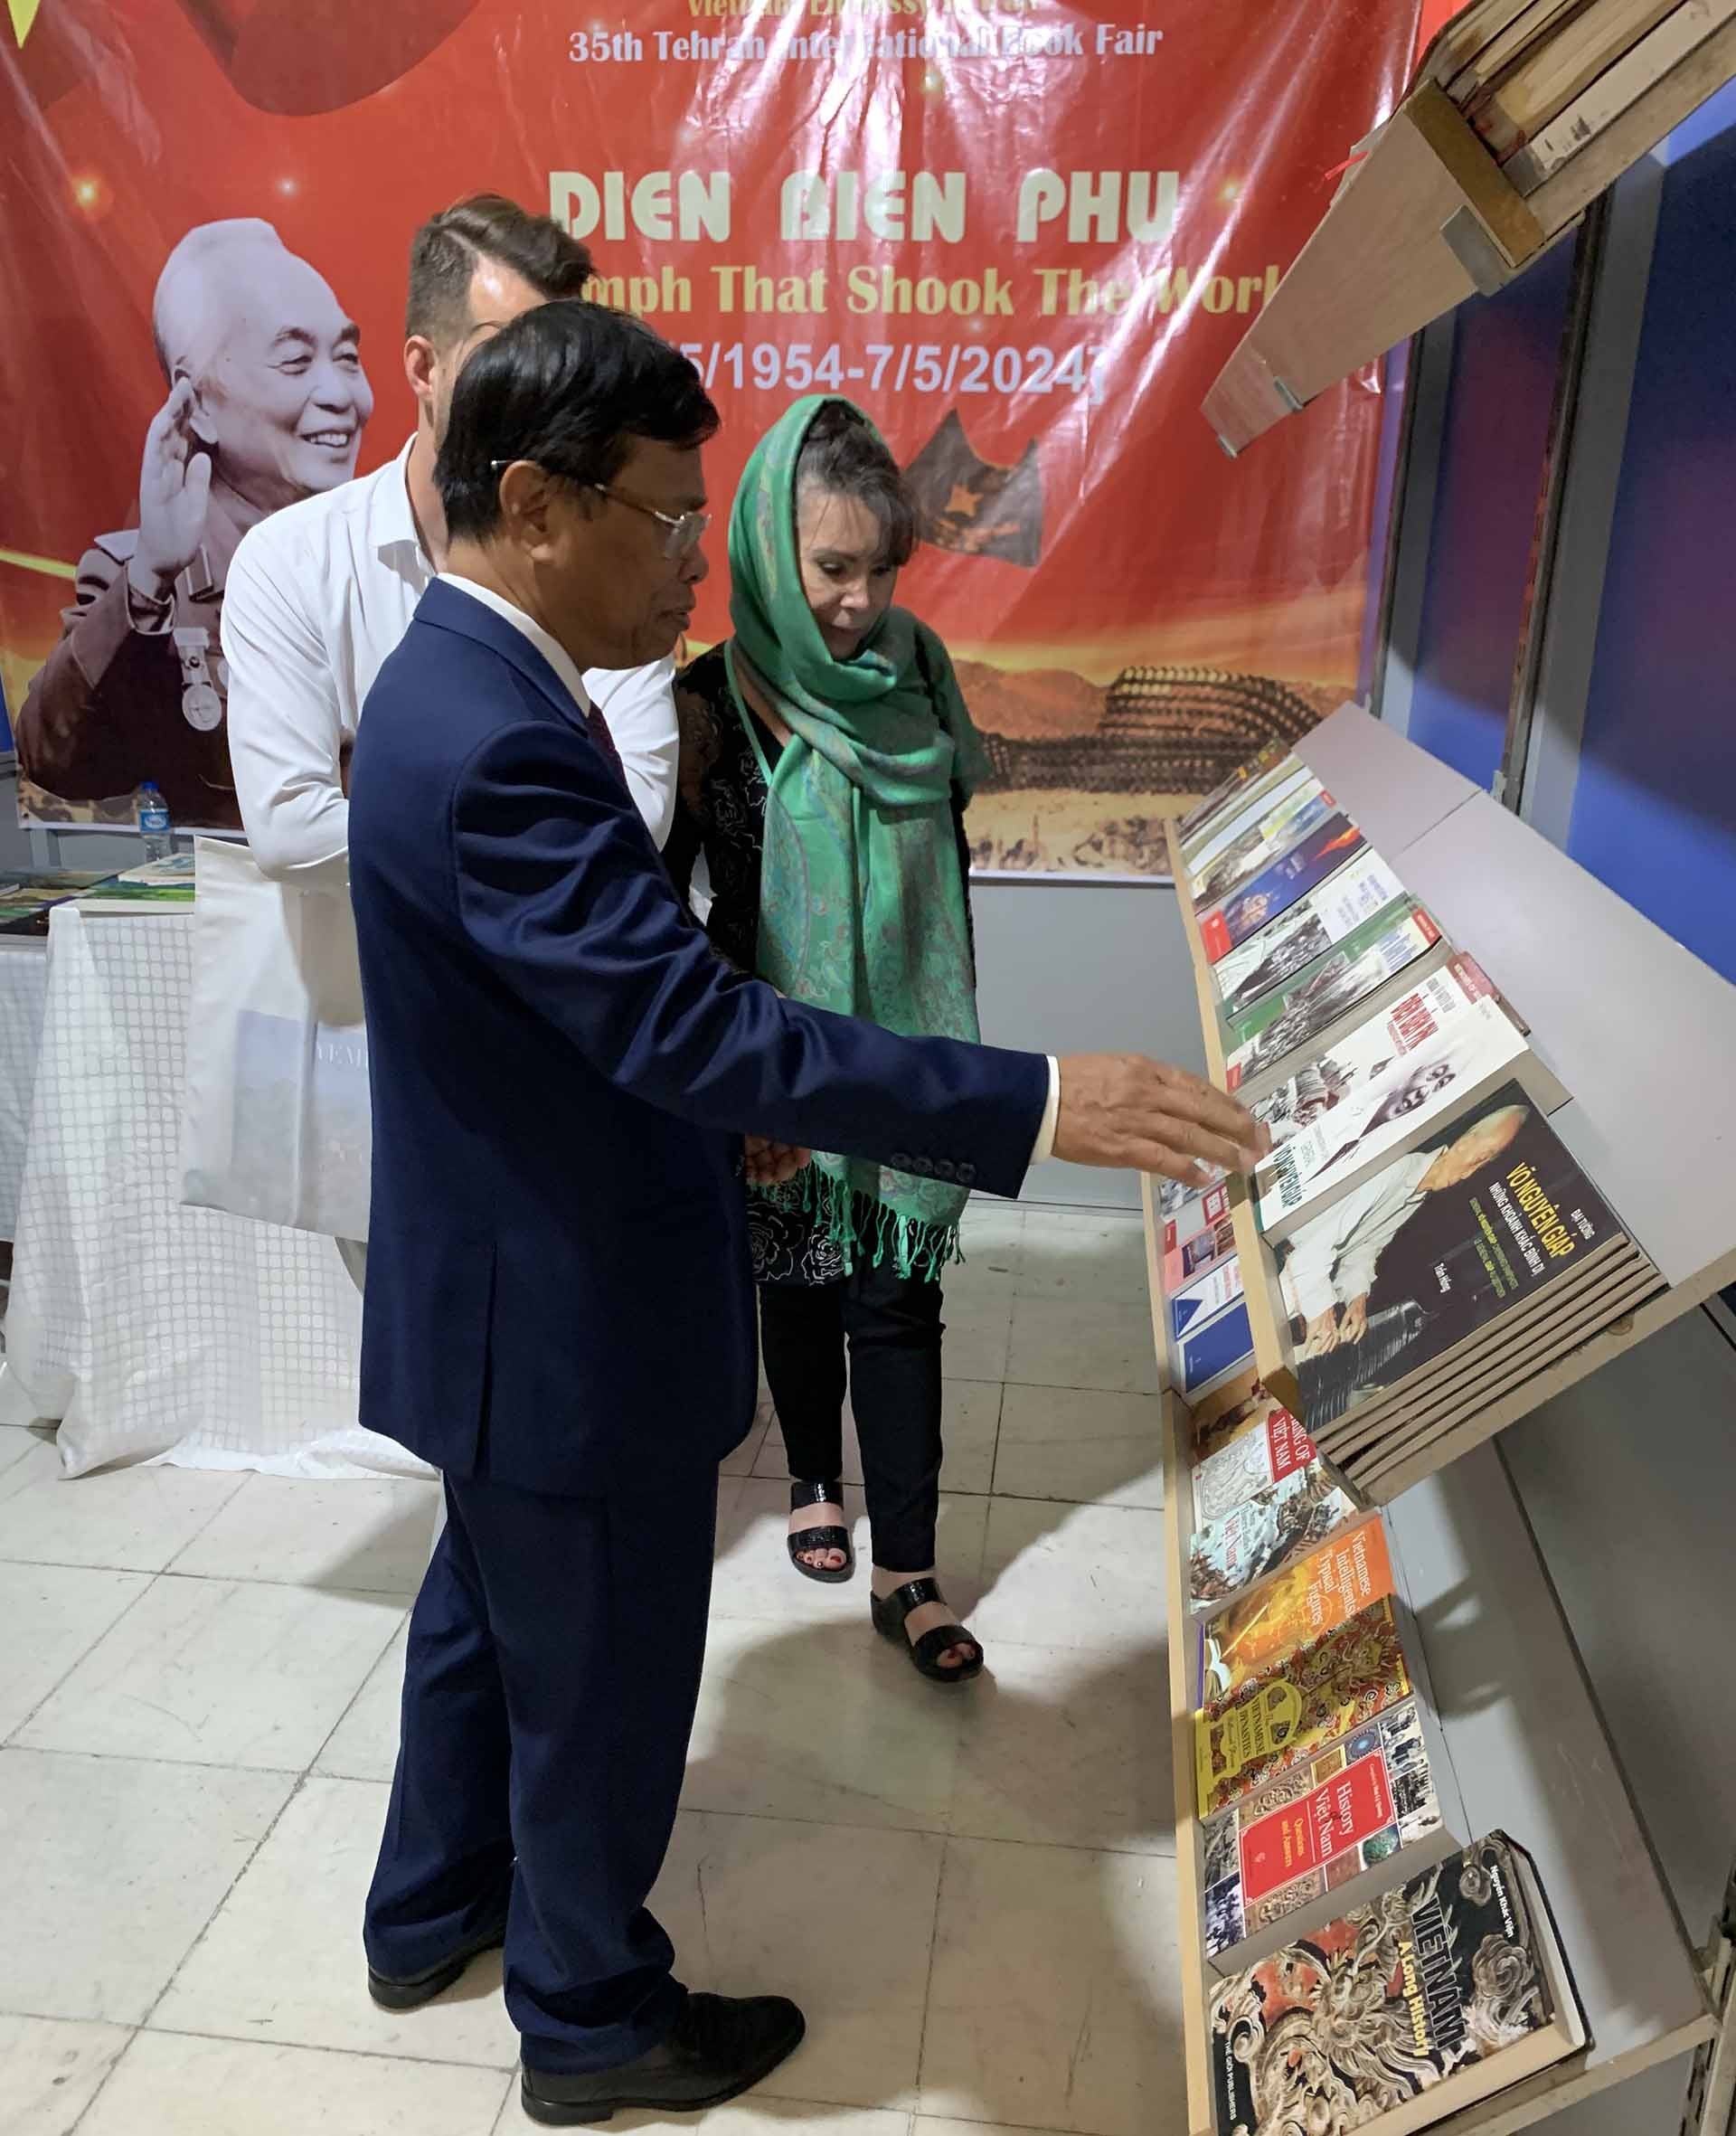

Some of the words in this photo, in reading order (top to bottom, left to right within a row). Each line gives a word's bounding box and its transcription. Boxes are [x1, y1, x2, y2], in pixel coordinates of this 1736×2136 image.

[569, 33, 642, 61] 35th
[657, 29, 766, 61] Tehran
[1096, 24, 1162, 56] Fair
[549, 171, 731, 242] DIEN
[780, 170, 966, 242] BIEN
[1017, 168, 1179, 243] PHU
[581, 266, 691, 318] mph
[711, 266, 829, 314] That
[846, 266, 1014, 316] Shook
[1033, 267, 1132, 317] The
[1151, 265, 1280, 313] Worl
[1505, 1162, 1535, 1188] VÕ
[1514, 1178, 1561, 1234] NGUYÊN
[1539, 1224, 1577, 1261] GIÁP
[1275, 1441, 1291, 1470] NAM
[1295, 1443, 1310, 1461] OF
[1317, 1549, 1340, 1593] Typical
[1352, 1530, 1373, 1597] Vietnamese
[1307, 1577, 1325, 1625] Figures
[1240, 1709, 1252, 1759] DYNASTIES
[1251, 1697, 1267, 1755] VIETNAMESE
[1313, 1788, 1333, 1822] Việt
[1335, 1781, 1355, 1834] History
[1281, 1835, 1292, 1867] Answers
[1292, 1818, 1305, 1857] Questions
[1316, 1819, 1333, 1857] Nam
[1396, 1939, 1414, 1959] A
[1399, 1953, 1420, 1998] Long
[1407, 1997, 1430, 2058] History
[1227, 2072, 1236, 2121] PUBLISHERS
